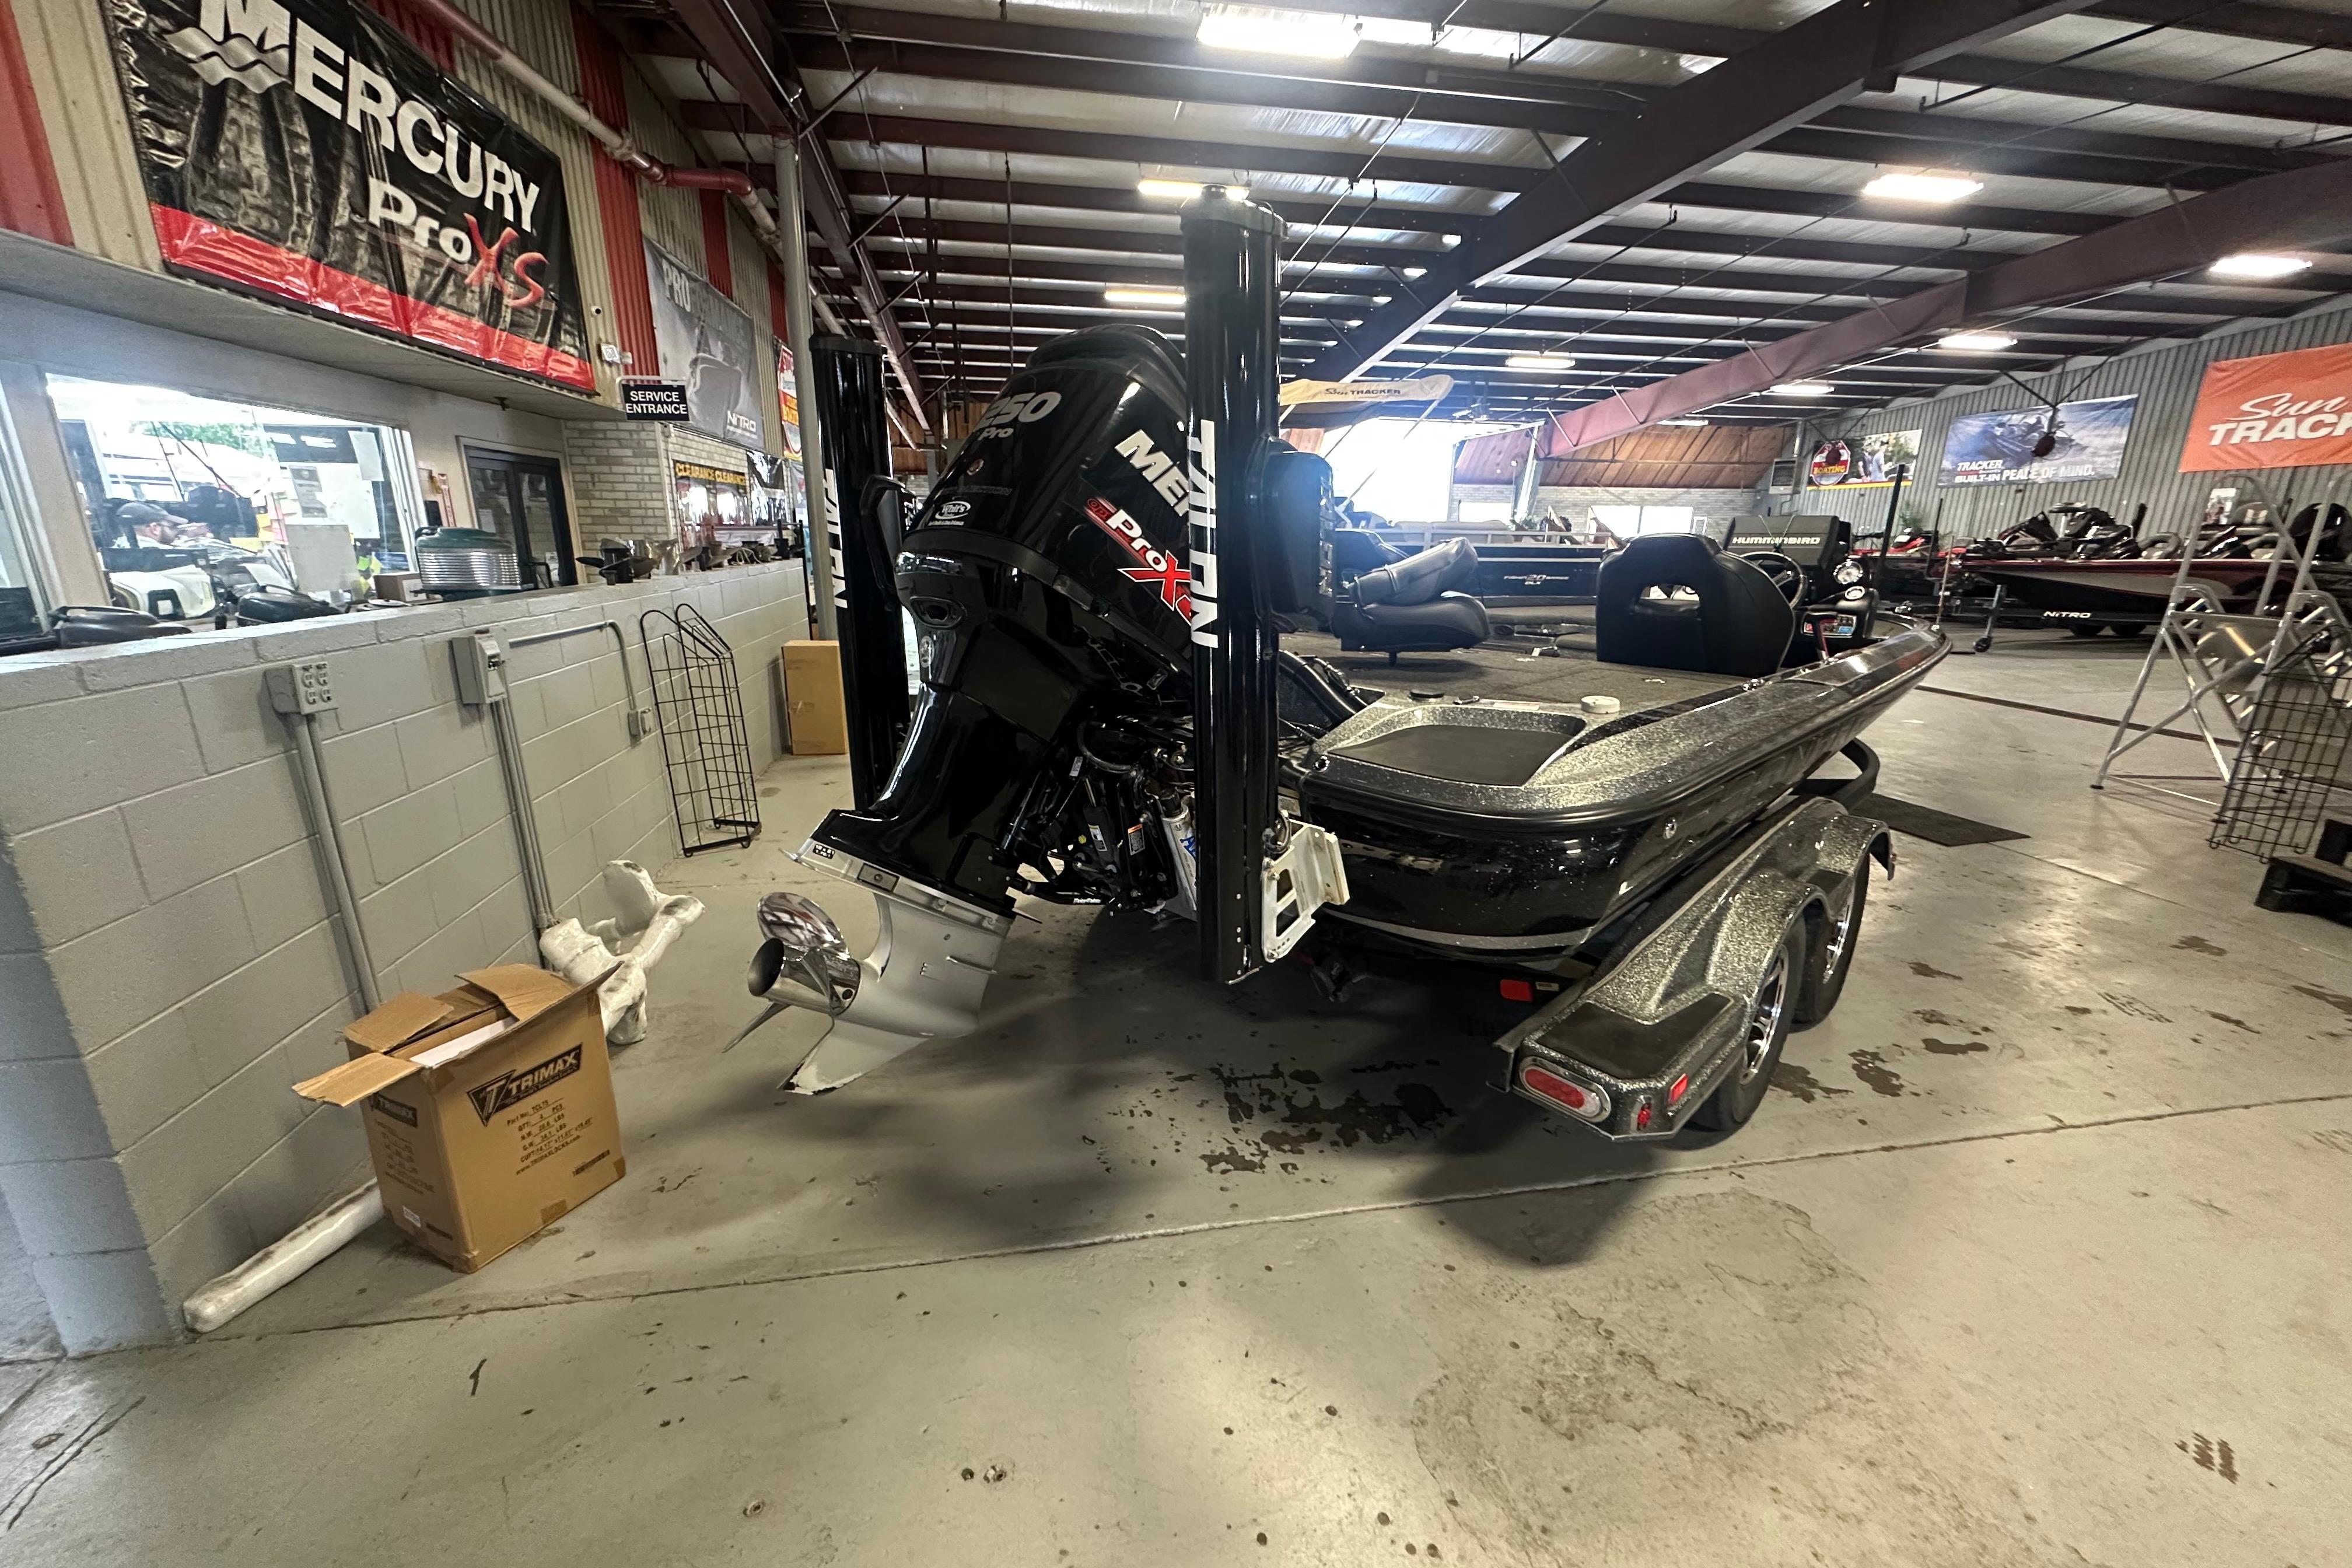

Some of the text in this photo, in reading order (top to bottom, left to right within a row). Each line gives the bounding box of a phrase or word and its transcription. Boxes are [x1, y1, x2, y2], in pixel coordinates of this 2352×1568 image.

[662, 258, 691, 313] PRO
[630, 391, 680, 402] SERVICE
[625, 403, 688, 414] ENTRANCE
[973, 391, 1062, 432] 250
[2224, 393, 2349, 421] Sun
[1957, 459, 2004, 471] TRACKER
[675, 463, 746, 484] CLEARANCE CLEARANCE
[1955, 473, 2001, 484] BUILT-IN
[2042, 466, 2058, 478] OF
[508, 1051, 578, 1095] TRIMAX
[552, 1102, 563, 1113] PCS
[554, 1112, 565, 1122] LBS
[556, 1122, 566, 1133] LBS
